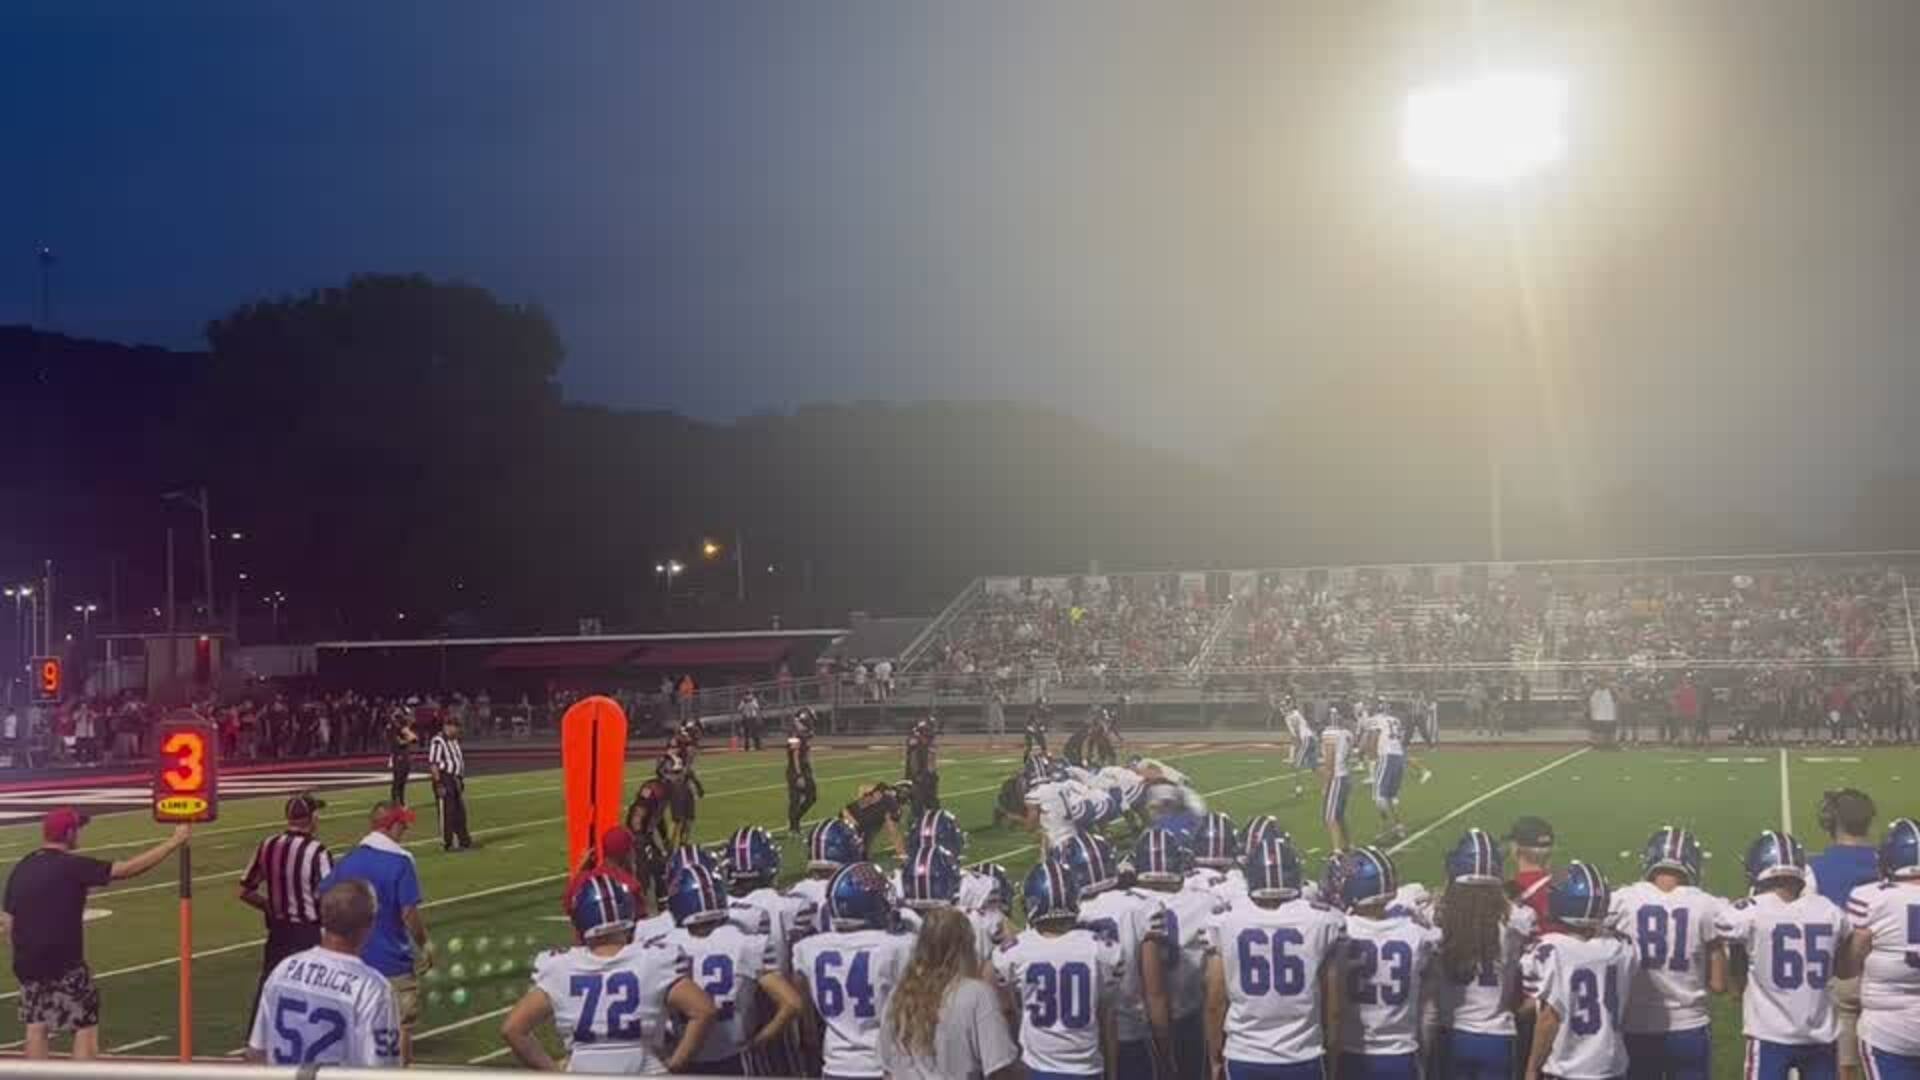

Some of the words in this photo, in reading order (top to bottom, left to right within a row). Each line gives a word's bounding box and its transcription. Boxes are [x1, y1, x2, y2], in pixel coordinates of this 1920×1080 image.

[43, 661, 57, 691] 9
[164, 732, 204, 791] 3
[1237, 927, 1305, 996] 66
[1637, 904, 1689, 971] 81
[1771, 923, 1833, 990] 65
[287, 959, 359, 995] PATRICK
[570, 971, 642, 1042] 72
[815, 950, 876, 1019] 64
[1025, 961, 1090, 1029] 30
[273, 995, 347, 1066] 52
[373, 1028, 401, 1058] 52
